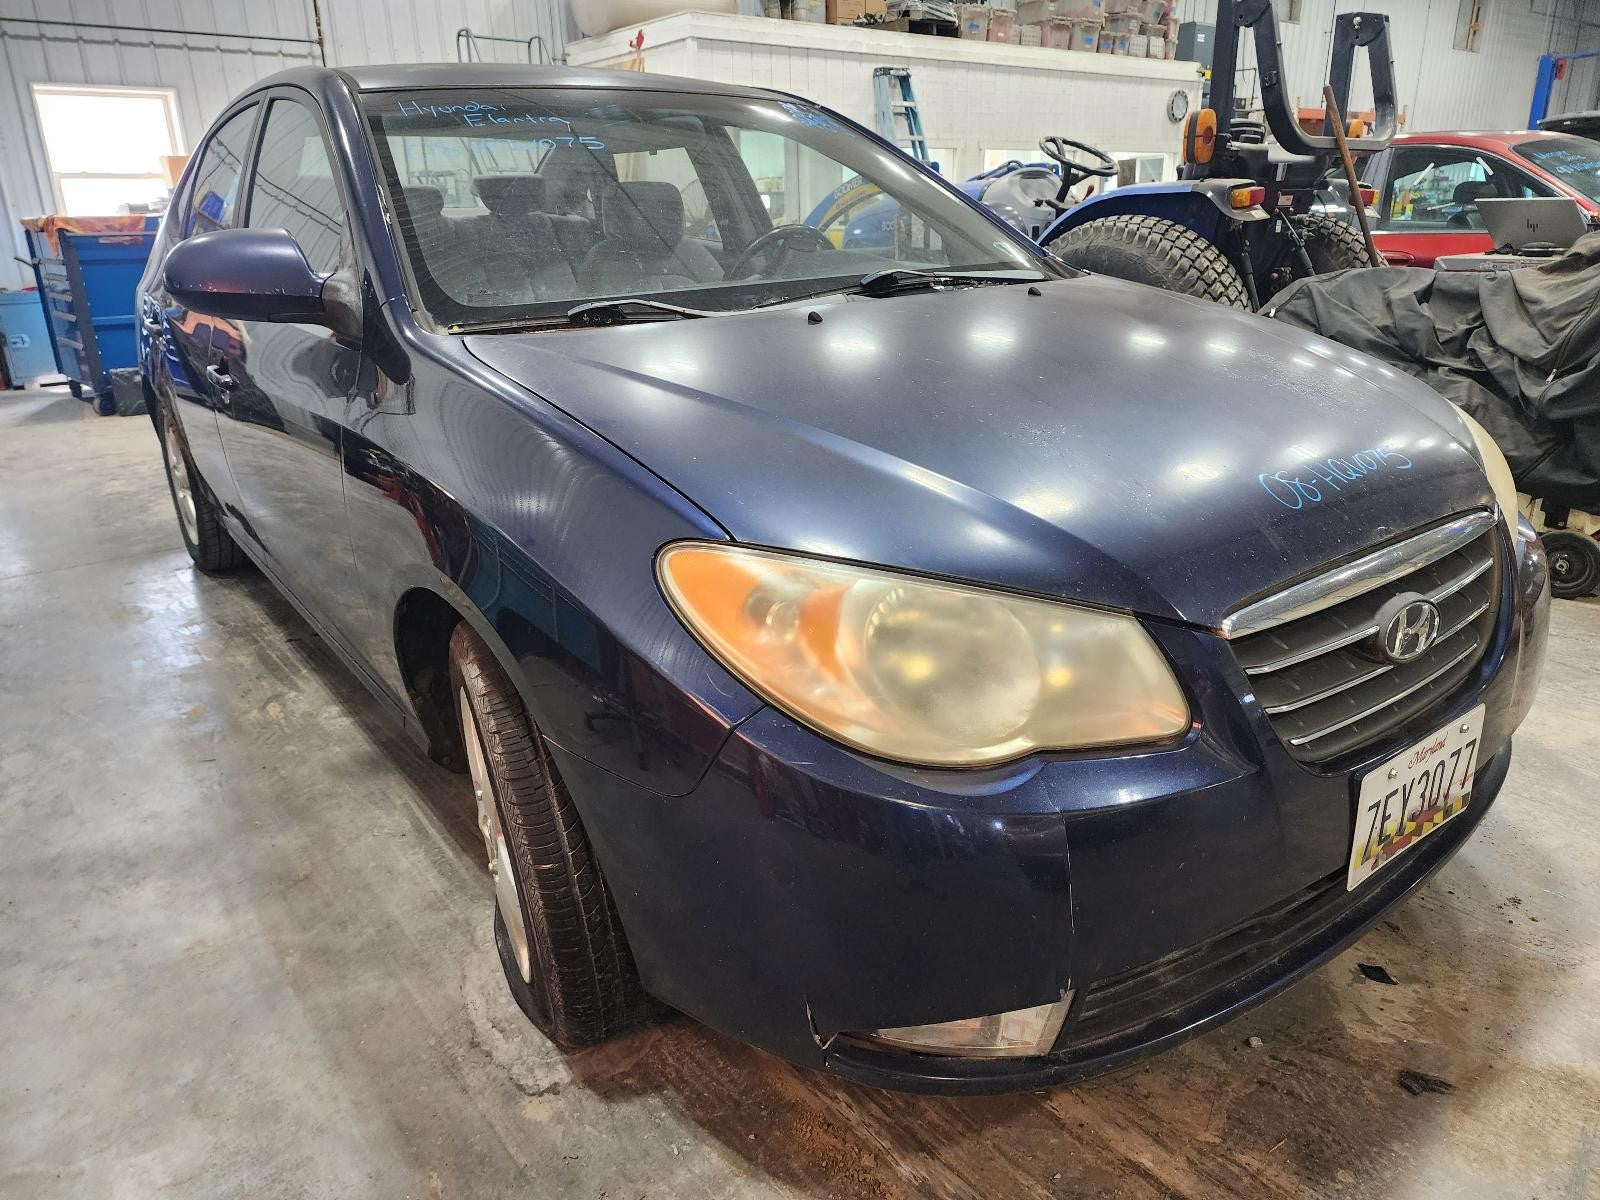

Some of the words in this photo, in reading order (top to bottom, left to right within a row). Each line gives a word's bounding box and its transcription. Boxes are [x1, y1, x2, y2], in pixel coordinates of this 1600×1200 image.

[398, 100, 505, 118] Hyundai
[464, 113, 571, 132] Elantra
[1361, 738, 1477, 866] 7EY3077
